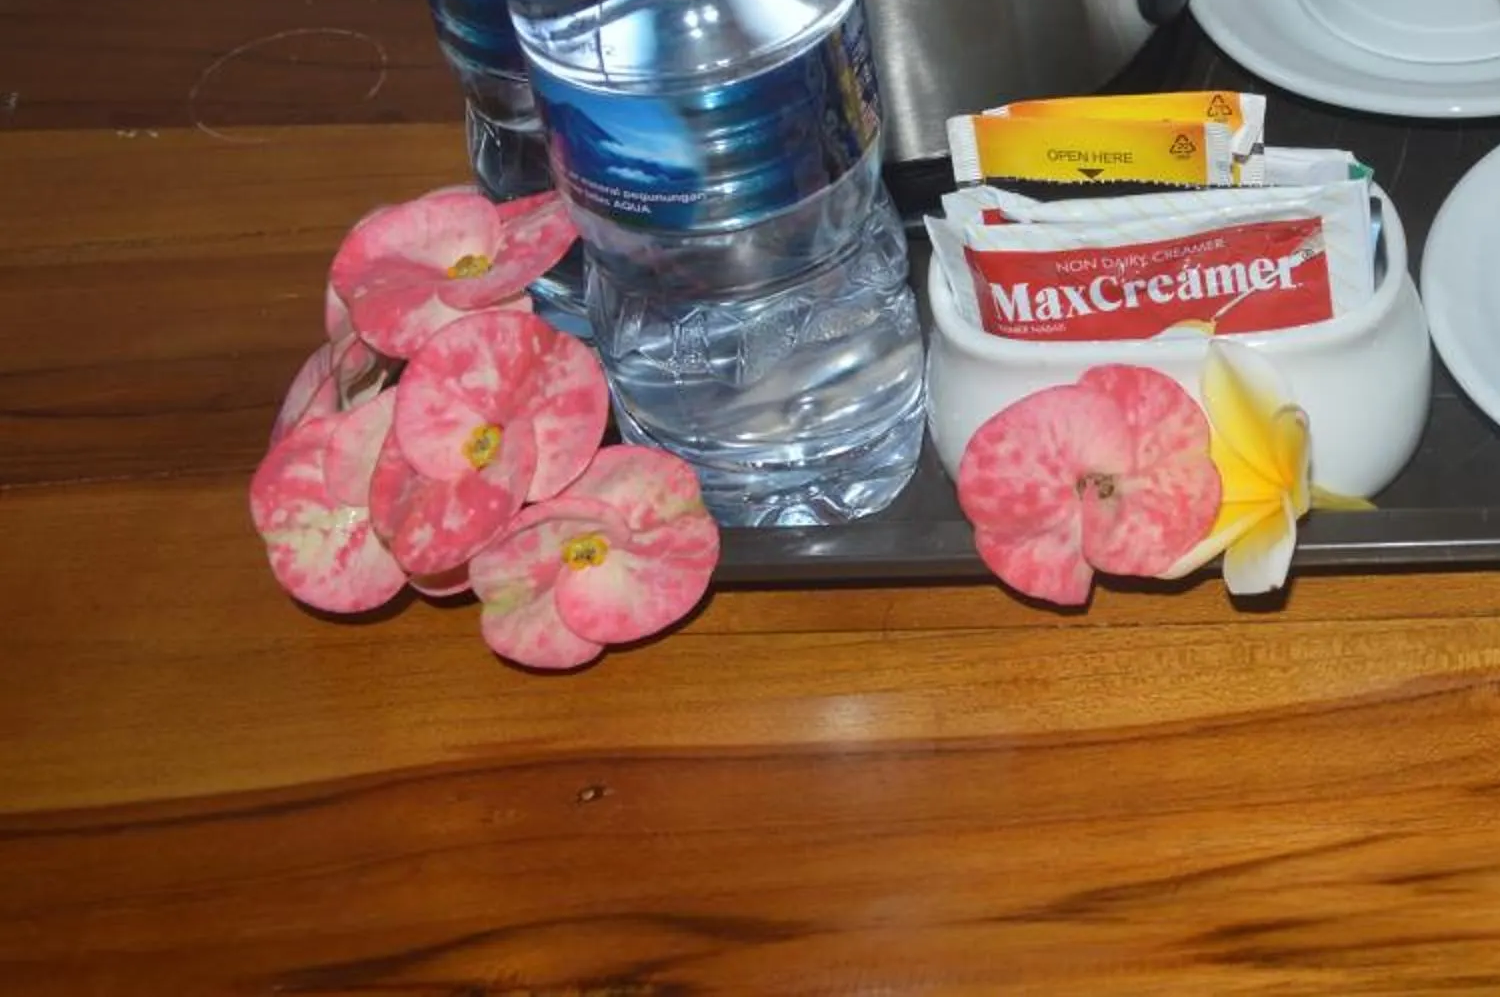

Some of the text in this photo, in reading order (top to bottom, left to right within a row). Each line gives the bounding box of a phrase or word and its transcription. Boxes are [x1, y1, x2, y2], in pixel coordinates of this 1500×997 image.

[1046, 148, 1134, 164] OPEN HERE
[613, 200, 652, 214] AQUA
[1055, 238, 1227, 274] NON DAIRY CREAMER
